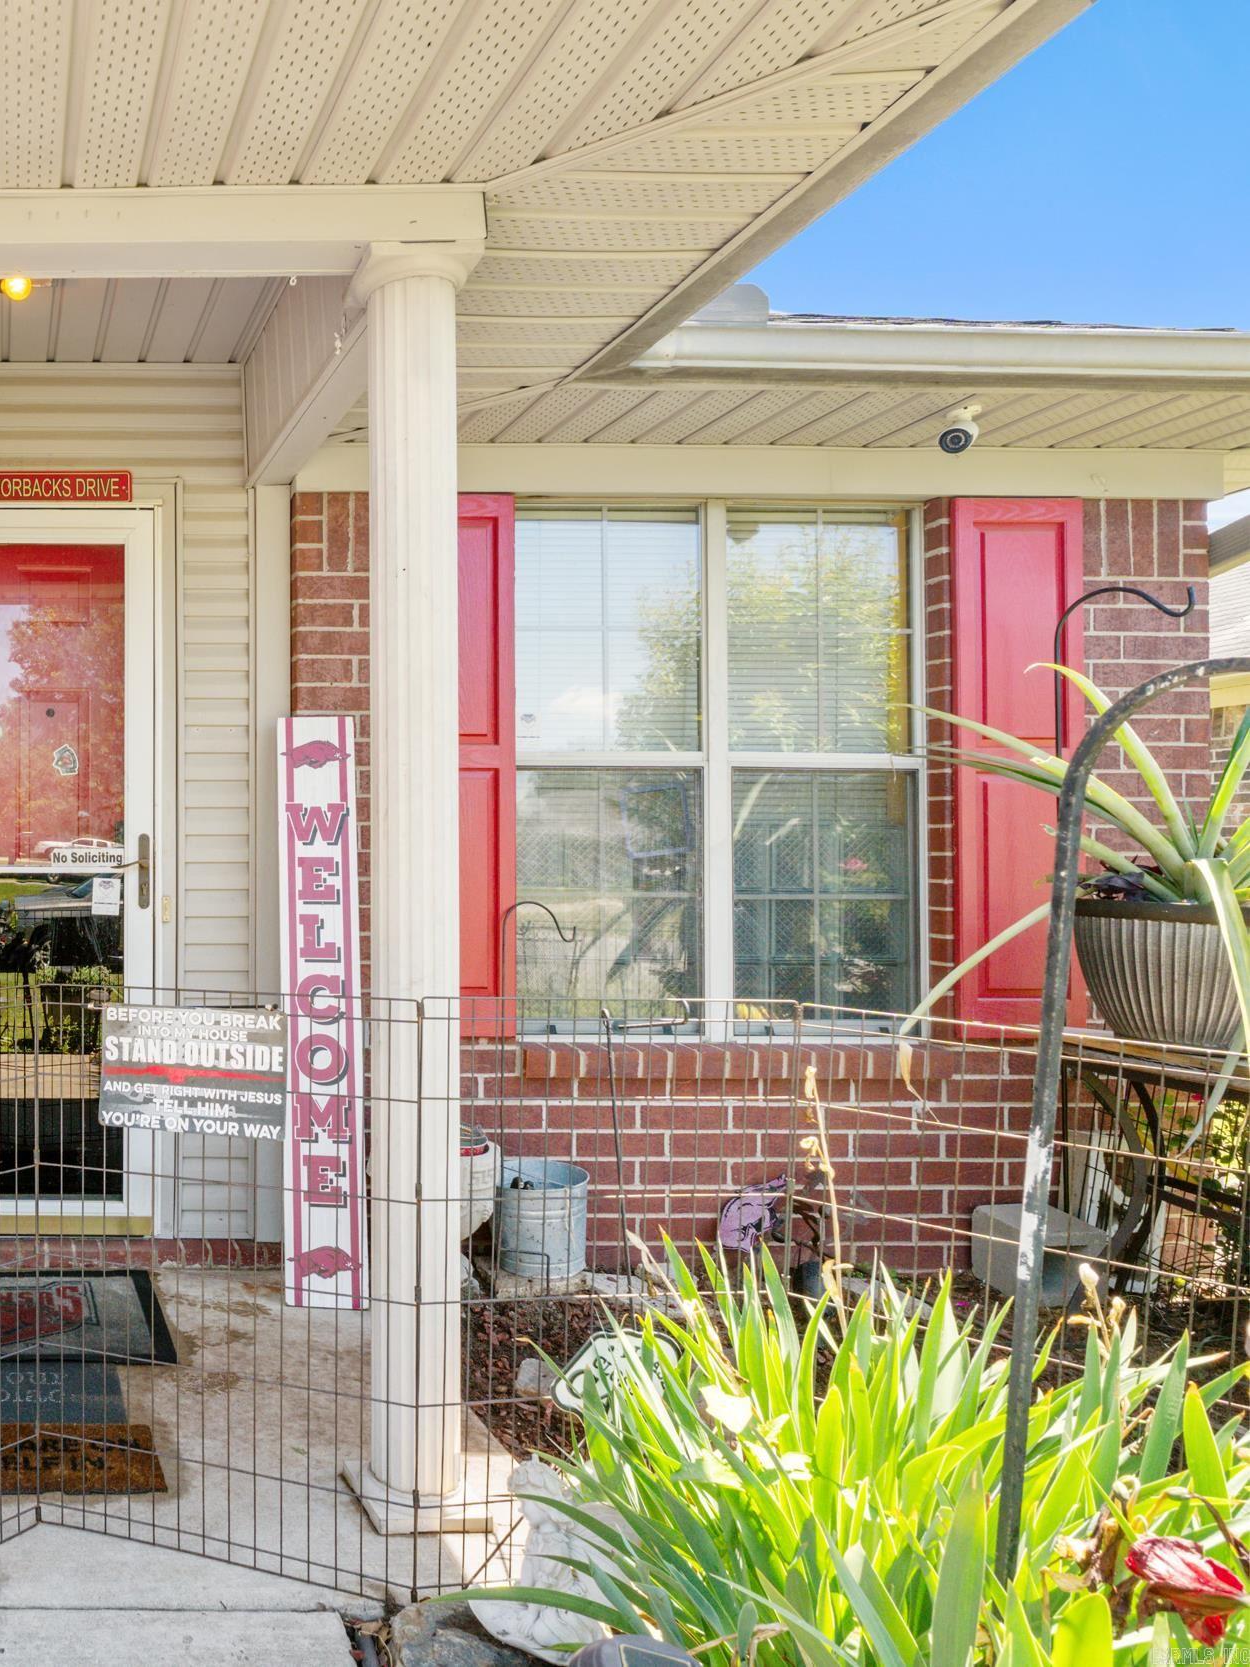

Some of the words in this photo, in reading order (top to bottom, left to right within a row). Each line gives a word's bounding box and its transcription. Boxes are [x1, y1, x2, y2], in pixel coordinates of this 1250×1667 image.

[76, 478, 120, 497] DRIVE
[52, 852, 68, 863] No
[71, 852, 123, 866] Soliciting
[285, 802, 353, 1208] WELCOME
[106, 1007, 174, 1024] BEFORE
[179, 1011, 216, 1027] YOU
[221, 1014, 282, 1031] BREAK
[138, 1025, 171, 1038] INTO
[174, 1027, 195, 1039] MY
[199, 1029, 248, 1042] HOUSE
[104, 1036, 177, 1065] STAND
[184, 1041, 284, 1073] OUTSIDE
[103, 1080, 132, 1093] AND
[134, 1082, 159, 1094] GET
[162, 1084, 200, 1098] RIGHT
[203, 1087, 238, 1101] WITH
[240, 1090, 282, 1105] JESUS
[152, 1098, 192, 1115] TELL
[197, 1101, 230, 1118] HIM
[102, 1110, 161, 1129] YOU'RE
[165, 1117, 190, 1132] ON
[192, 1119, 240, 1137] YOUR
[243, 1123, 282, 1140] WAY
[15, 1437, 79, 1452] ARE
